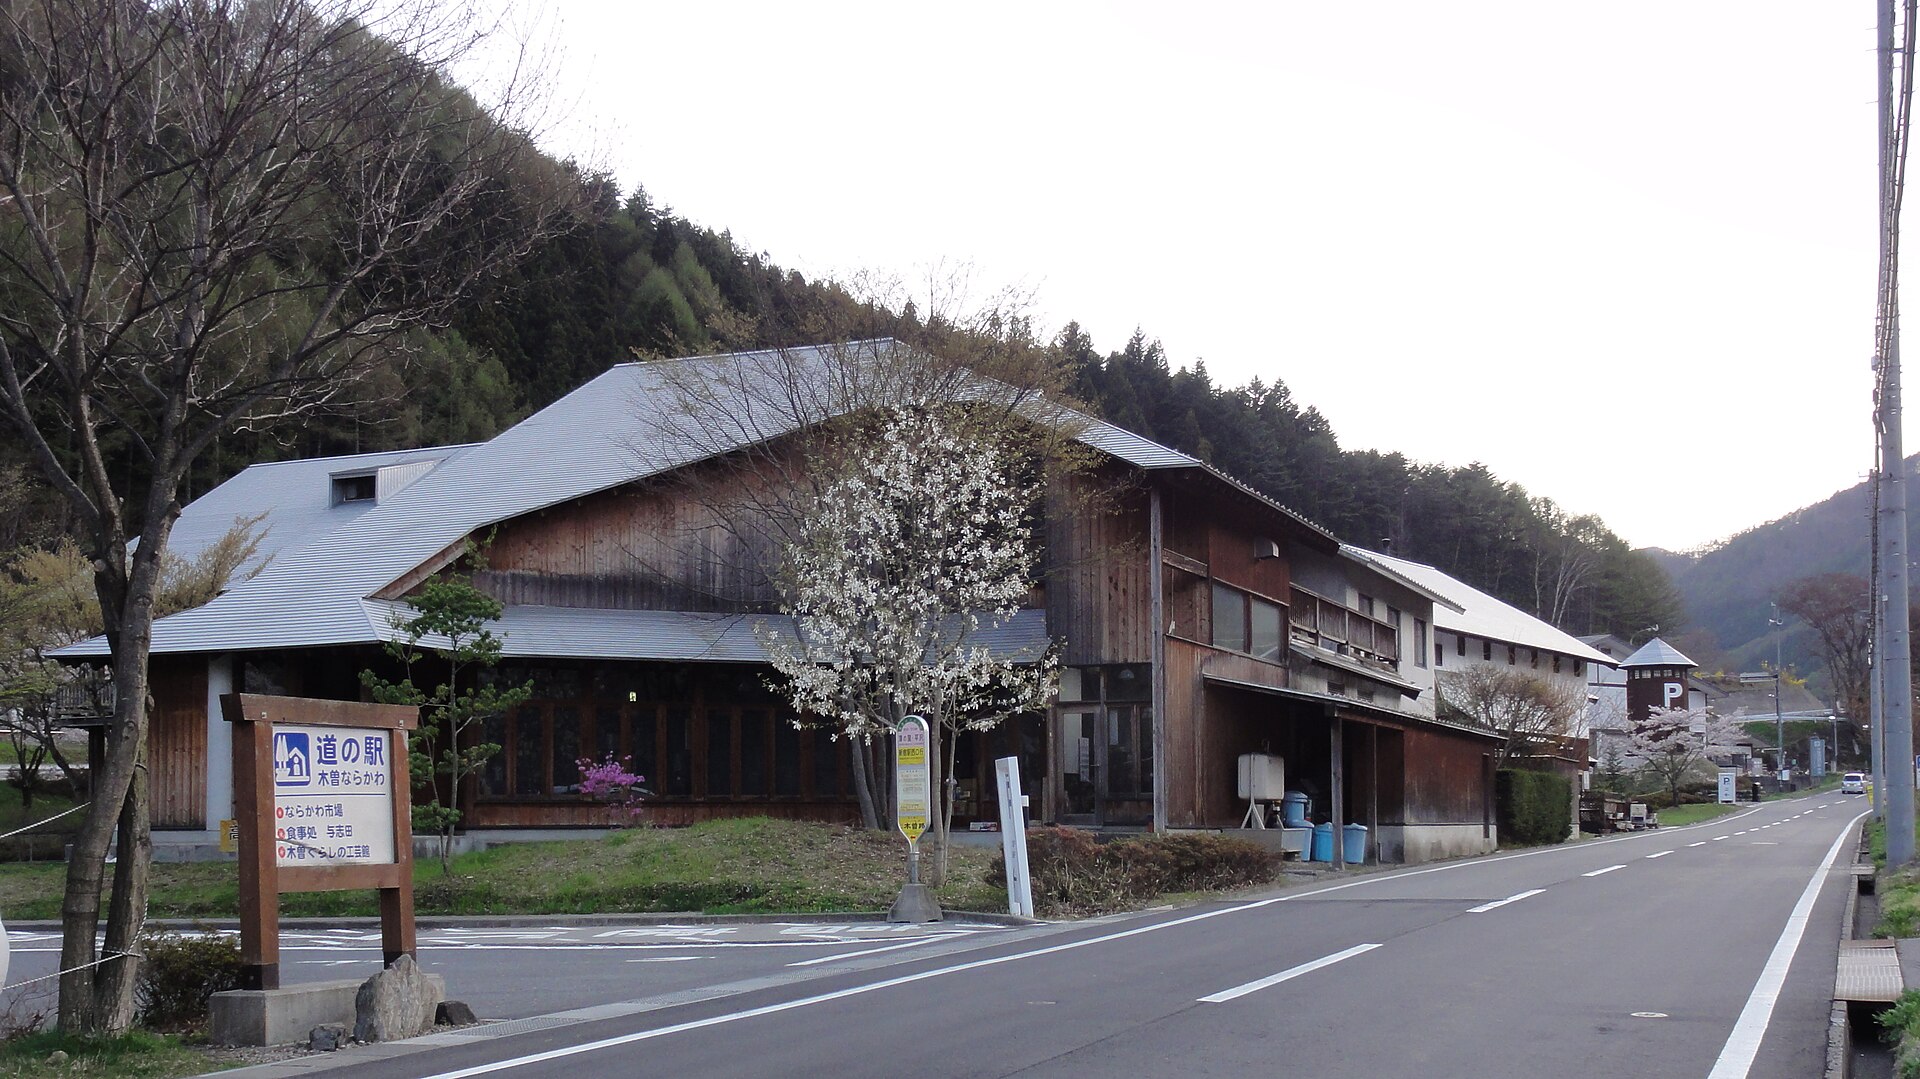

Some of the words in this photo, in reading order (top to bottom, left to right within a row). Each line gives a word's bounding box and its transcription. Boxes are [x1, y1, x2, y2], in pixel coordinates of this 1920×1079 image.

[1664, 683, 1683, 708] P
[316, 734, 384, 765] 道の駅
[318, 770, 385, 787] 木曽ならかわ
[1723, 777, 1730, 785] P
[285, 803, 344, 818] ならかわ市場
[286, 826, 317, 840] 食事処
[326, 824, 353, 838] 与志田
